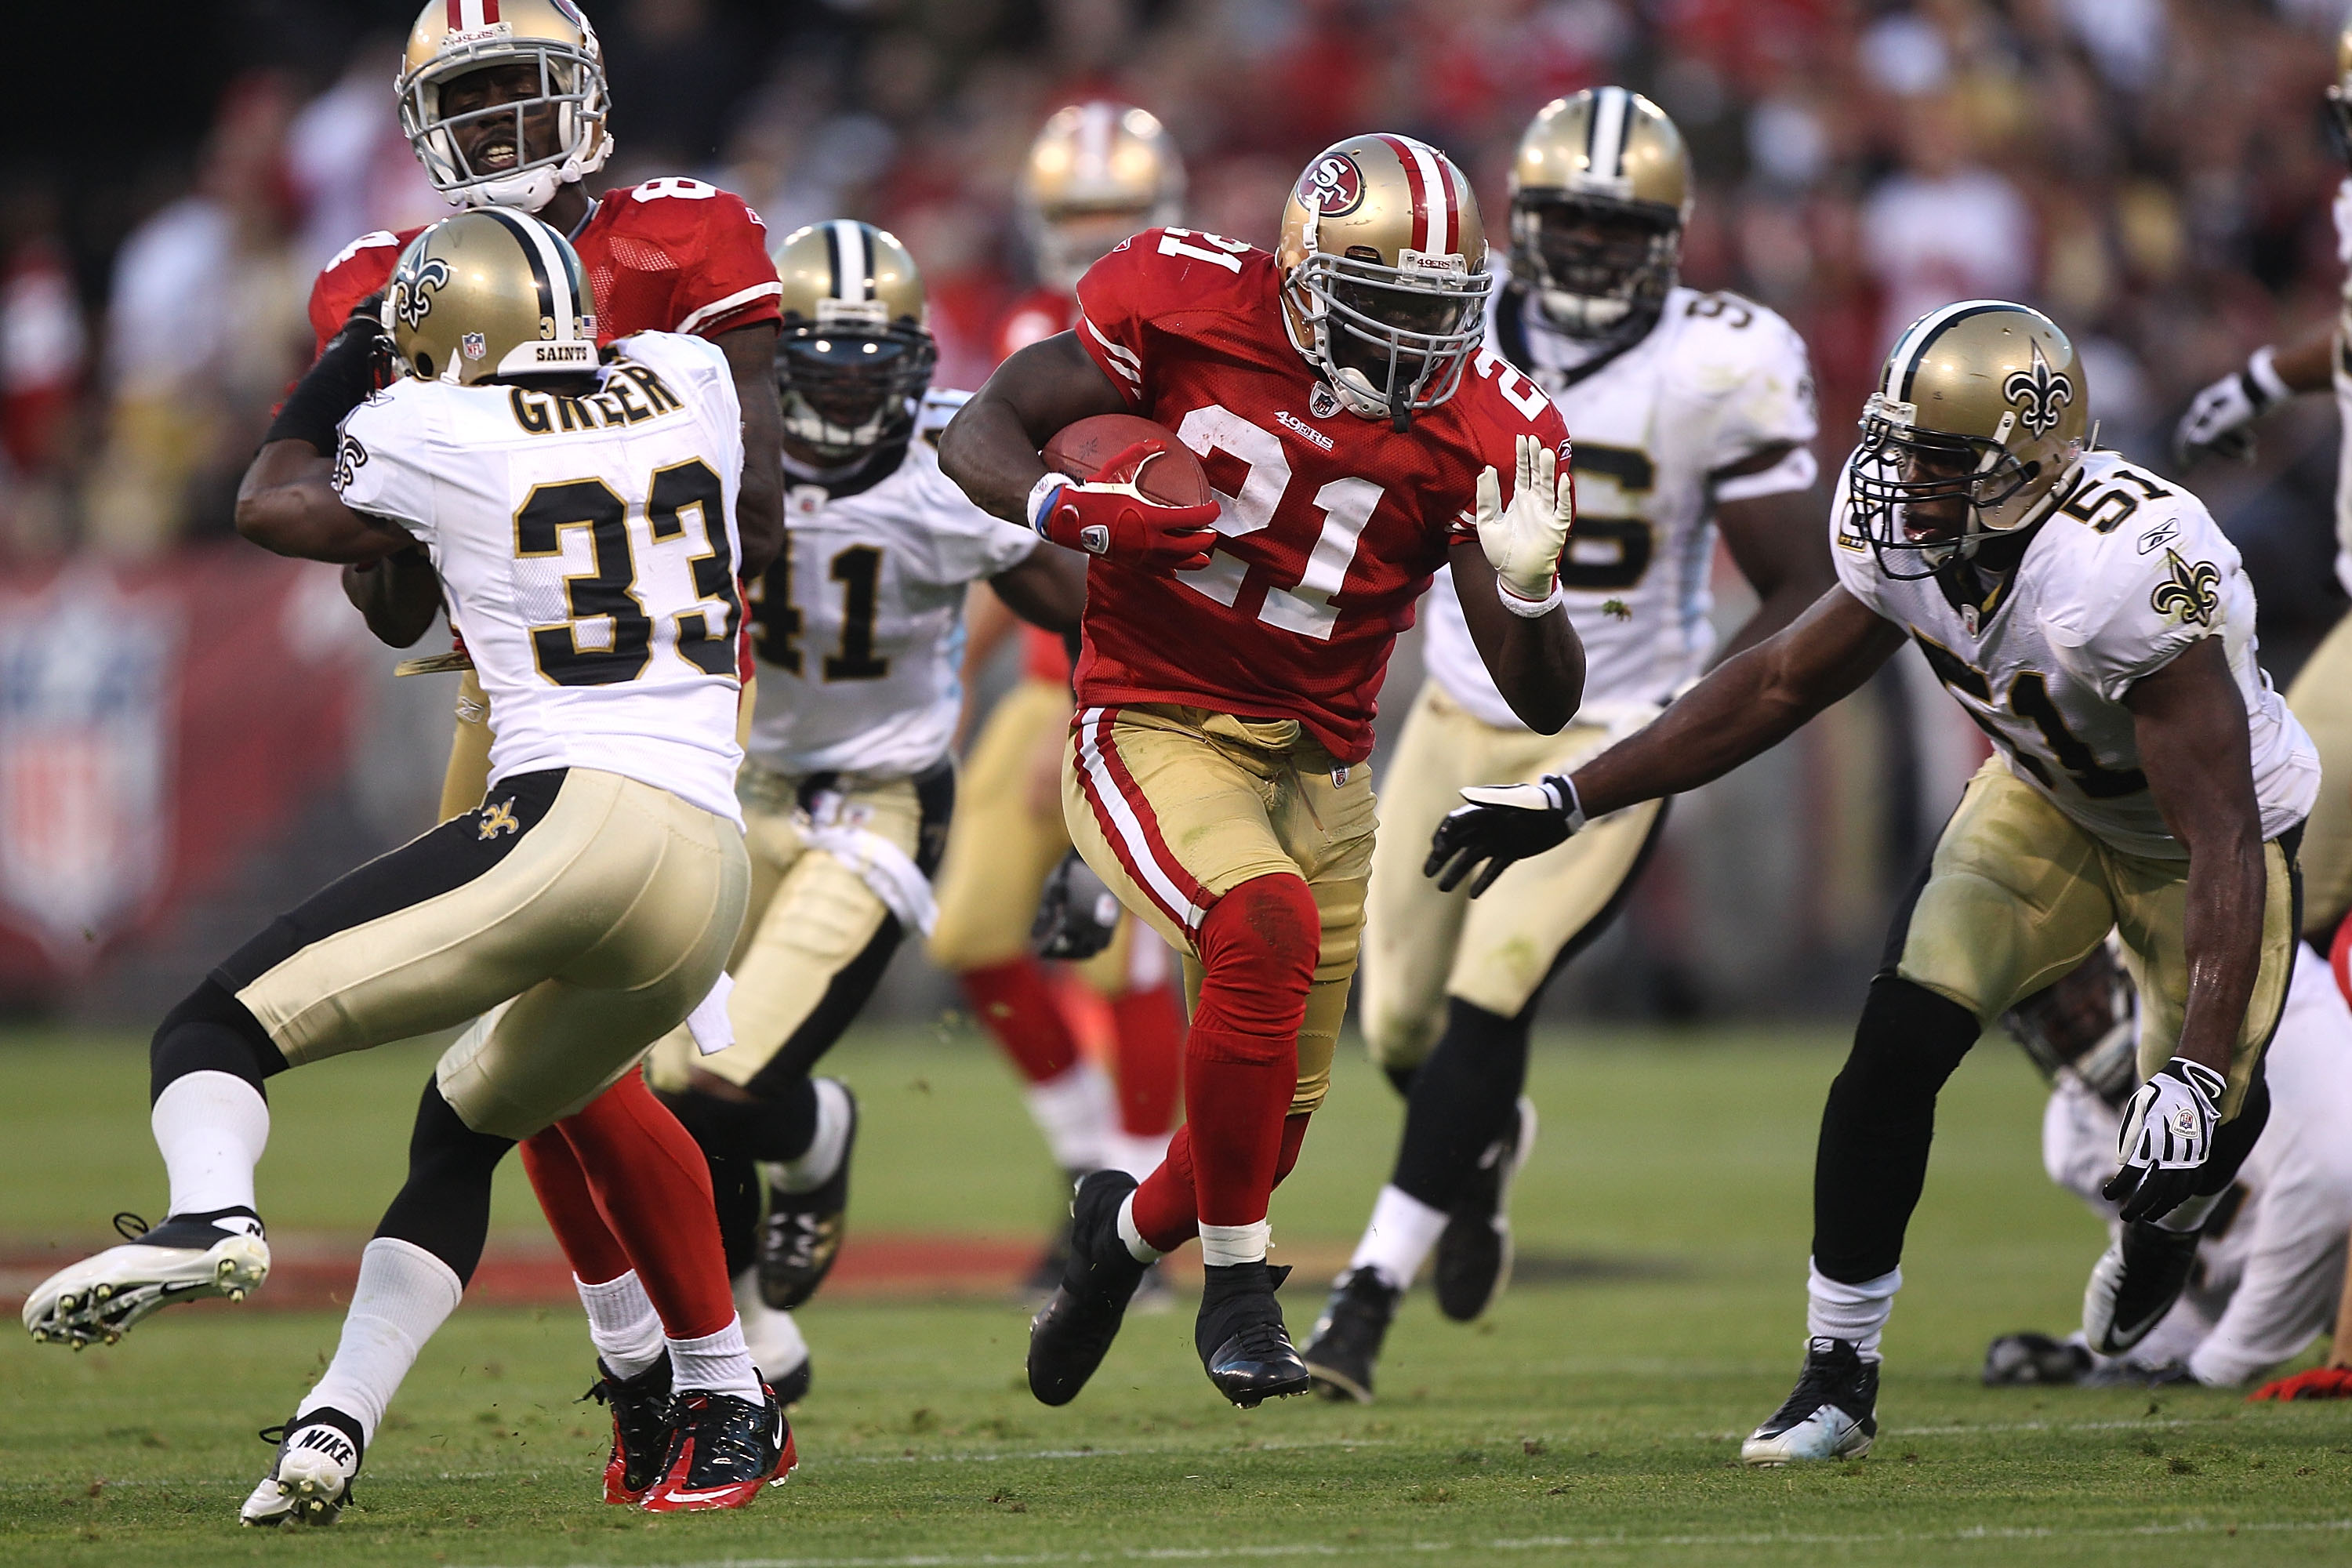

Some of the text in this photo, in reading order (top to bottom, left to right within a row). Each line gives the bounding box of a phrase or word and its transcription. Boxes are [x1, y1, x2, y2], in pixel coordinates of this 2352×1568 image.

[1417, 258, 1450, 269] 49ERS
[466, 343, 484, 356] NFL
[536, 347, 587, 361] SAINTS
[509, 366, 684, 435] GREER
[1315, 400, 1330, 414] NFL
[1274, 411, 1334, 452] 49ERS
[2057, 470, 2176, 535] 51
[1174, 404, 1385, 641] 21
[512, 456, 742, 687] 33
[745, 528, 891, 684] 41
[2182, 1114, 2193, 1123] NFL
[297, 1429, 354, 1467] NIKE
